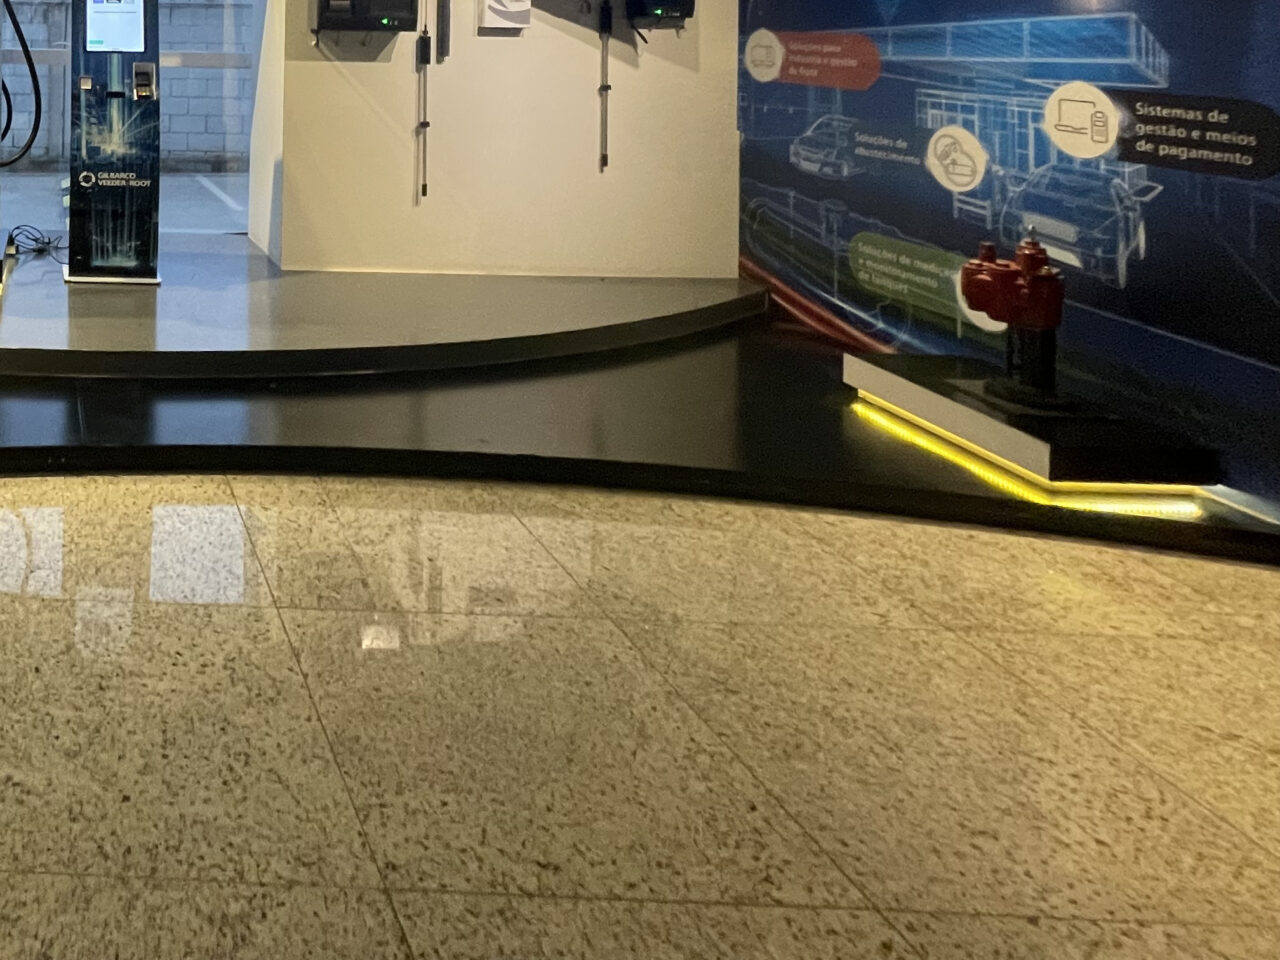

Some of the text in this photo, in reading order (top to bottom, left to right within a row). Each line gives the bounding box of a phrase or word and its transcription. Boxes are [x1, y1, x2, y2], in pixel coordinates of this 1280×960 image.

[1135, 102, 1230, 124] Sistemas de
[1135, 123, 1257, 146] gestão e meios
[1135, 140, 1253, 166] de pagamento
[98, 172, 136, 180] GILBARCO
